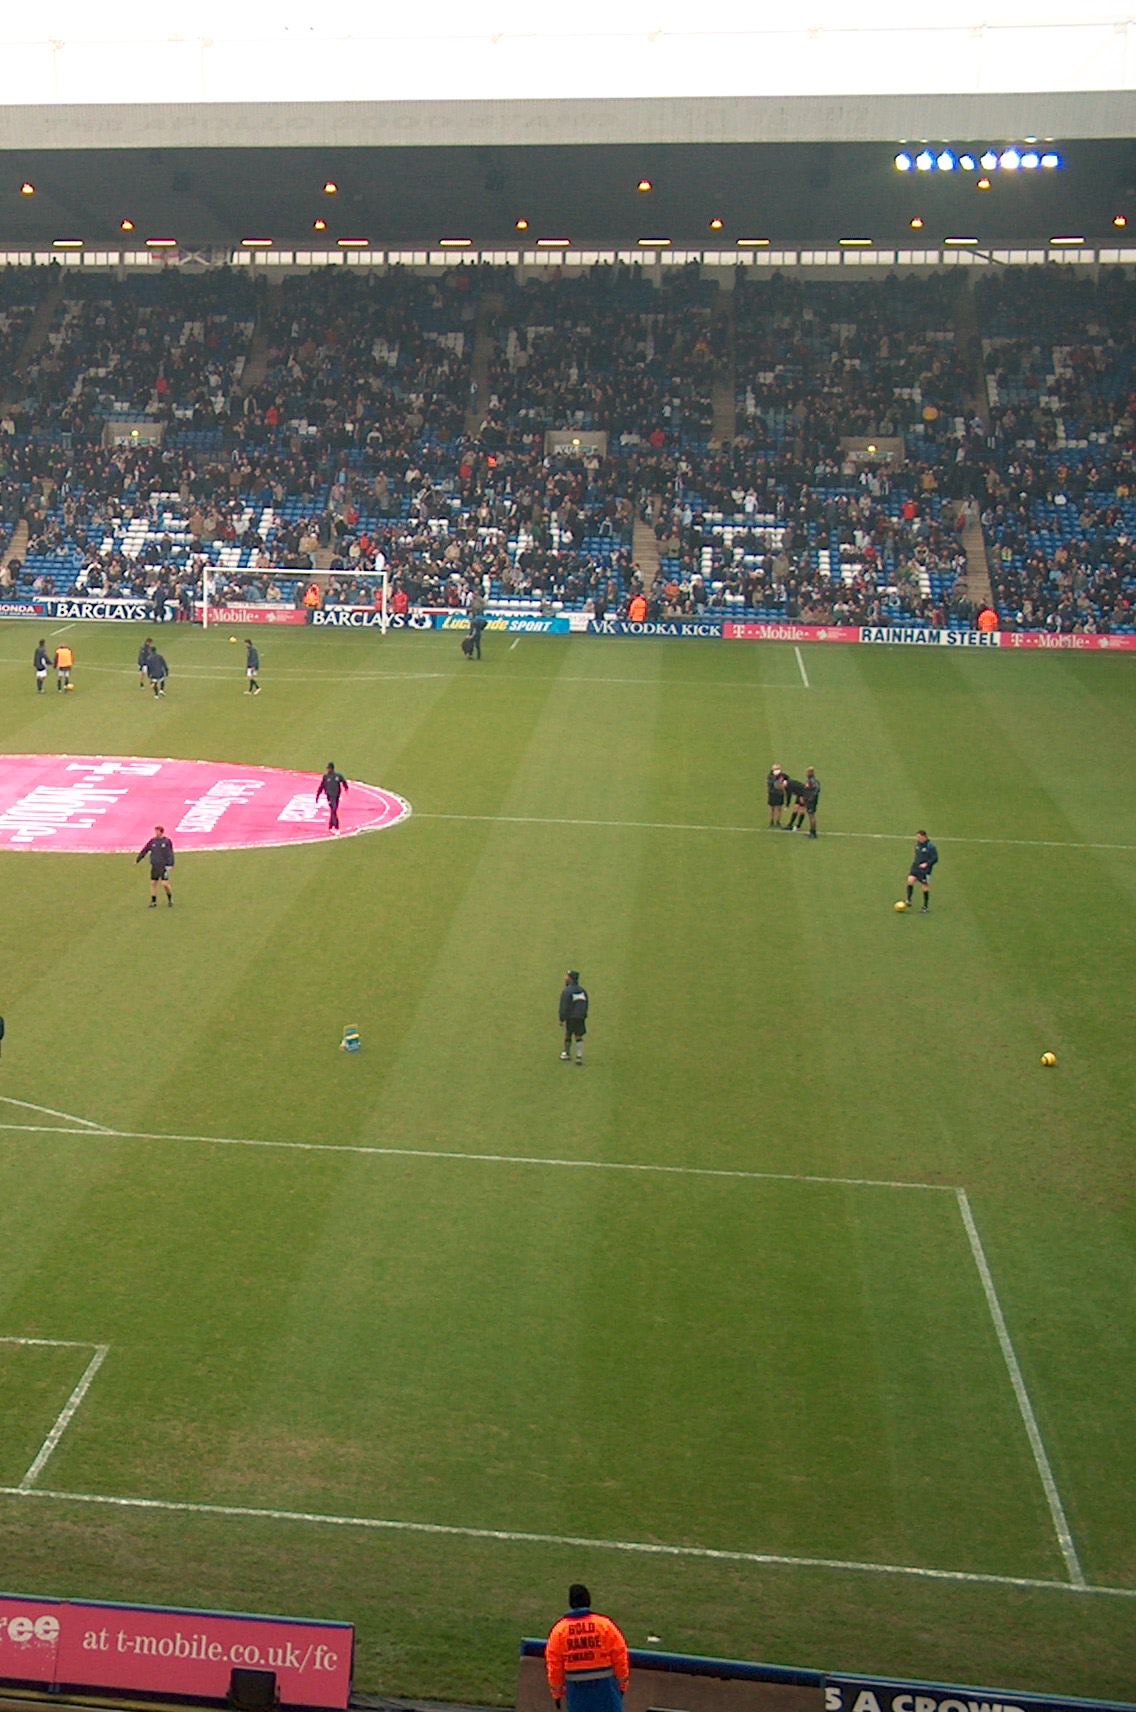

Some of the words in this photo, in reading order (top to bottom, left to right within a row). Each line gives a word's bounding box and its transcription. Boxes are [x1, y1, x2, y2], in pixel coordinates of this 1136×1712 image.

[57, 603, 146, 620] BARCLAYS
[313, 610, 405, 628] BARCLAYS
[509, 621, 552, 632] SPORT
[592, 620, 616, 634] VK
[621, 622, 678, 636] VODKA
[681, 624, 721, 637] KICK
[862, 628, 941, 644] RAINHAM
[947, 631, 999, 646] STEEL
[82, 1628, 110, 1651] at
[116, 1628, 339, 1673] t-mobile.co.uk/fc
[852, 1690, 882, 1711] A
